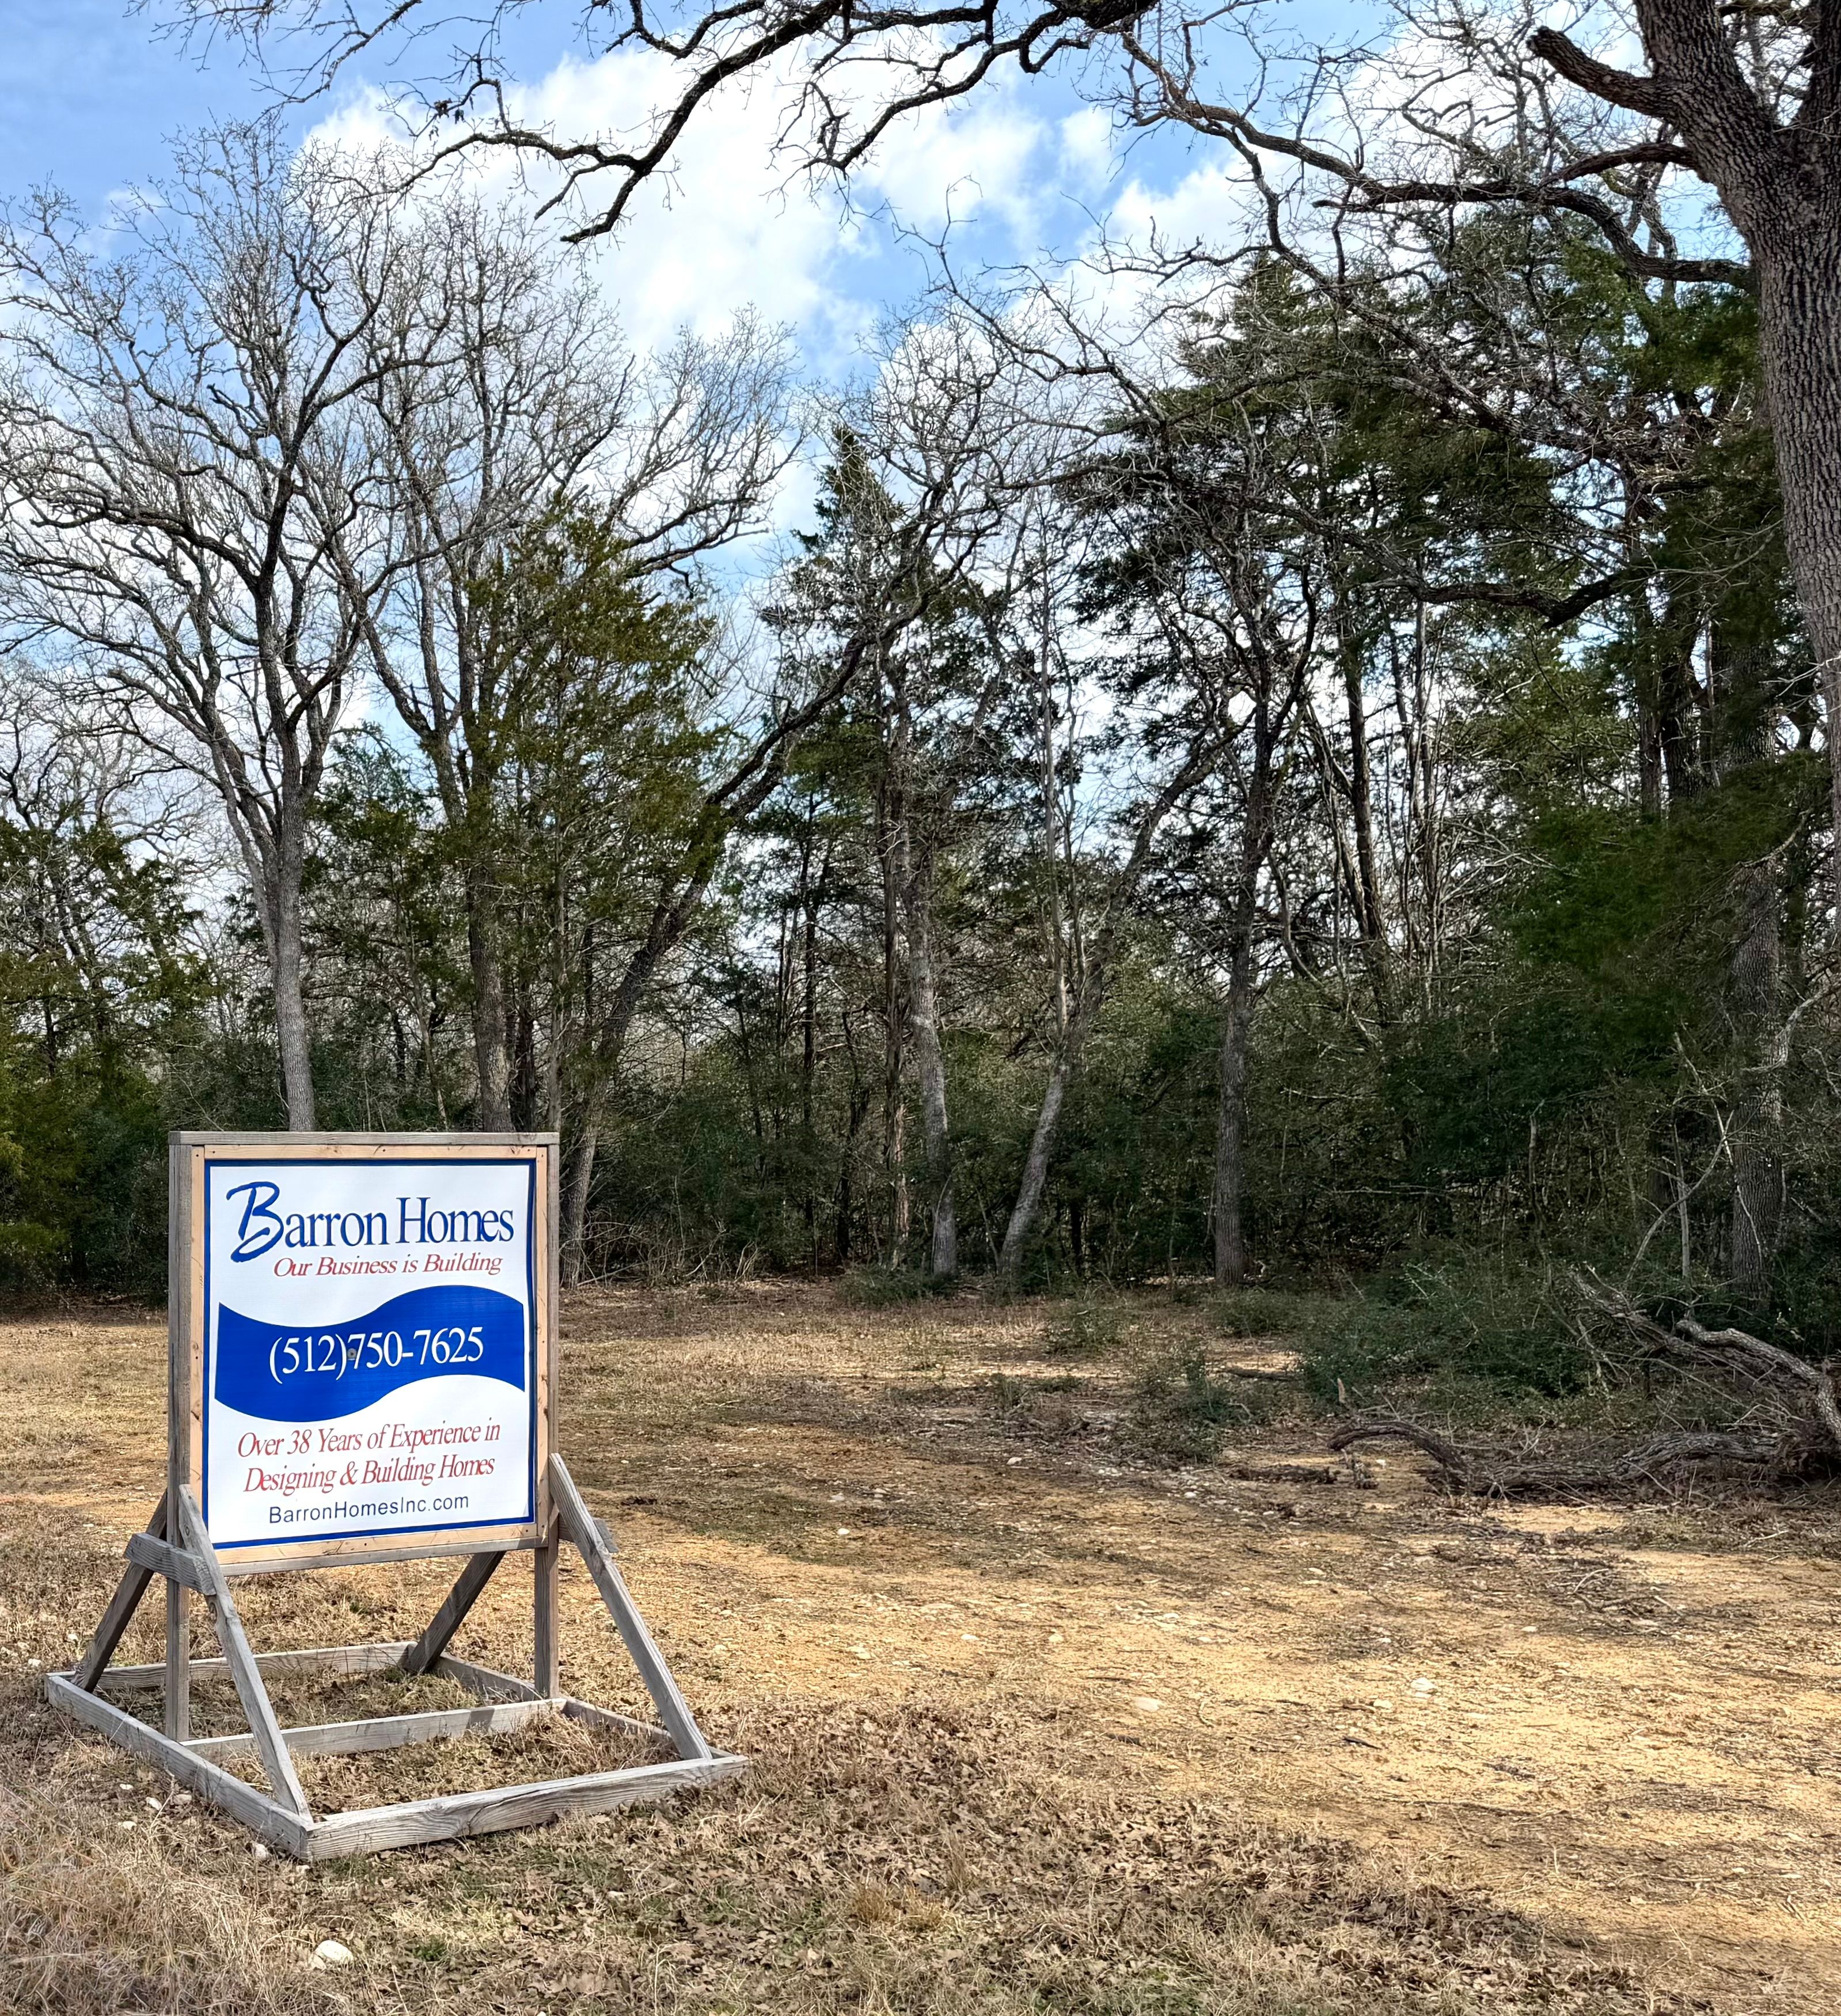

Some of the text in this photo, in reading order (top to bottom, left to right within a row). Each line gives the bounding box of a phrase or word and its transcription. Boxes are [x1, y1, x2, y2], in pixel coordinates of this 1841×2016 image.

[226, 1181, 514, 1263] Barron Homes
[274, 1253, 503, 1277] Our Business is Building
[269, 1327, 483, 1384] (512)750-7625
[238, 1418, 500, 1457] Over 38 Years of Experience in
[243, 1454, 495, 1495] Designing & Building Homes
[269, 1495, 469, 1523] BarronHomesInc.com
